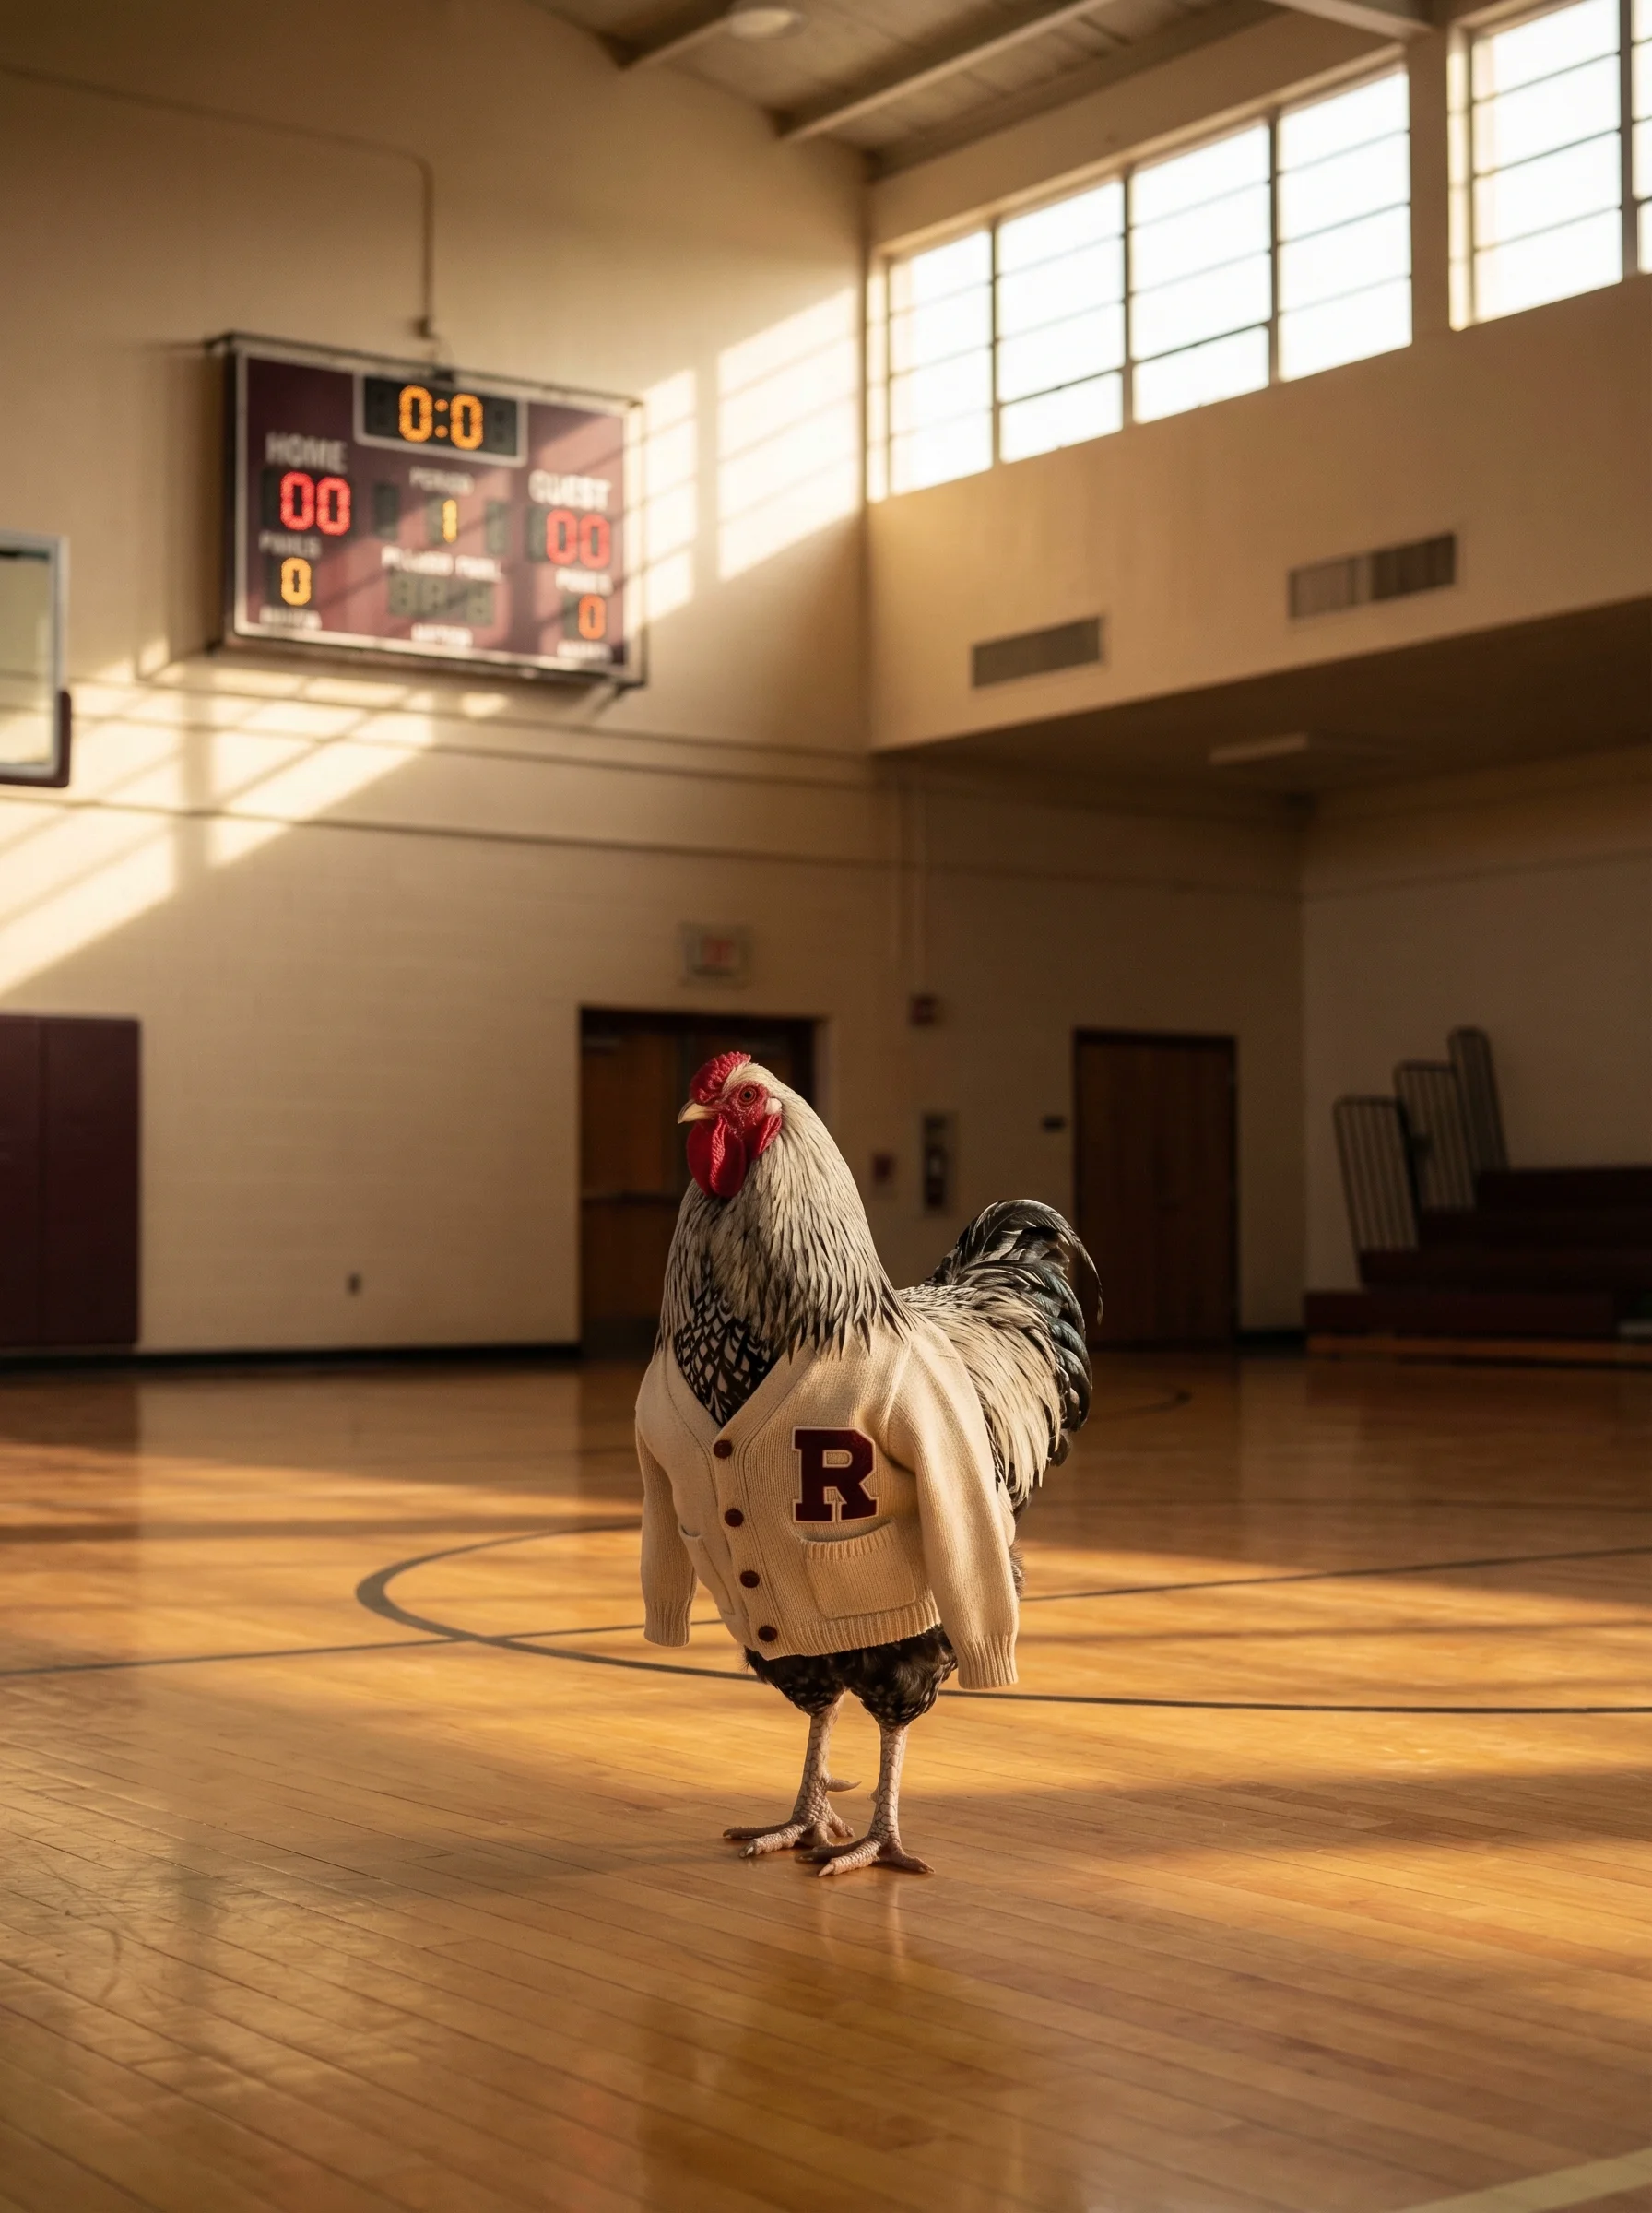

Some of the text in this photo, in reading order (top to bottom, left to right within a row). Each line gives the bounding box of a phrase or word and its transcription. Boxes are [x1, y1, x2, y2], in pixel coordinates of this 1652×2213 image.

[399, 385, 484, 451] 0:0
[265, 432, 348, 474] HOME
[280, 471, 350, 536] 00
[528, 469, 611, 511] GUEST
[442, 499, 457, 543] 1
[546, 509, 610, 569] 00
[281, 557, 311, 606] 0
[578, 594, 606, 640] 0
[792, 1426, 879, 1523] R
